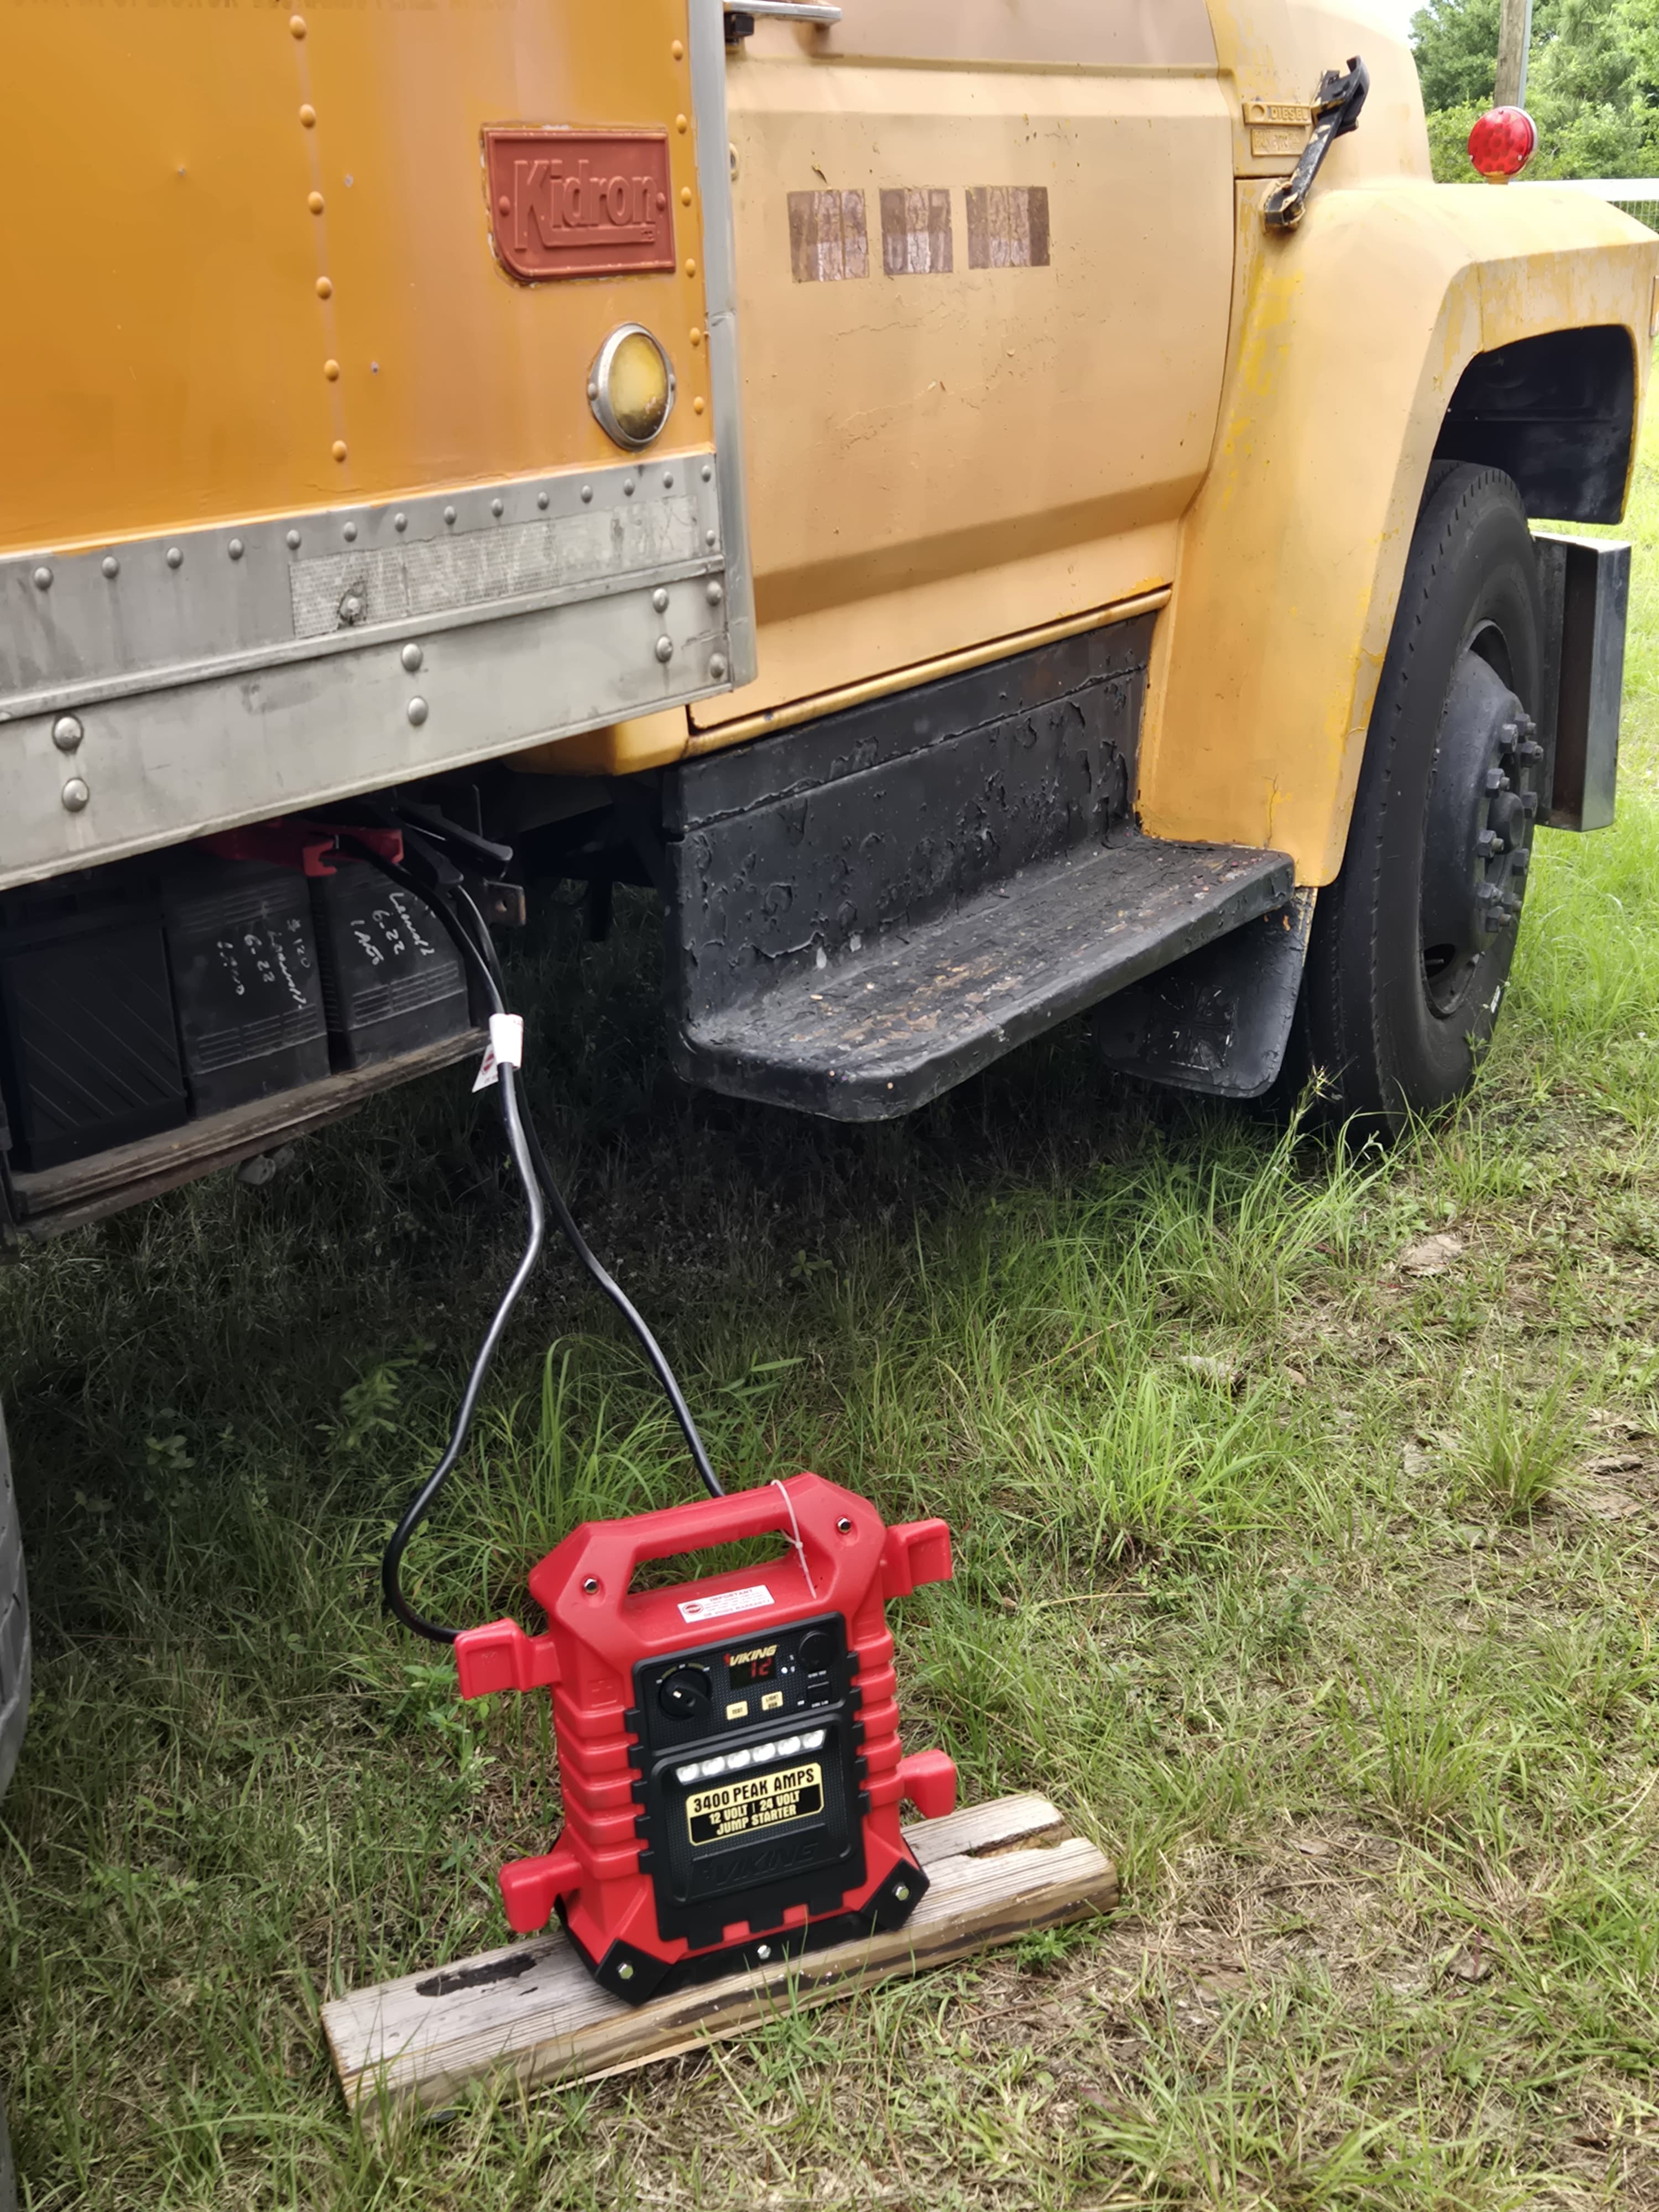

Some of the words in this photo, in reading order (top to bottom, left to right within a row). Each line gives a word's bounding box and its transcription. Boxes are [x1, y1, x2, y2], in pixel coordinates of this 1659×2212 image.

[1270, 107, 1308, 121] DIESEL
[514, 158, 657, 252] Kidron
[709, 1589, 753, 1601] IMPORTANT
[729, 1645, 778, 1667] VIKING
[750, 1657, 773, 1678] 12
[694, 1791, 730, 1813] 3400
[733, 1780, 768, 1802] PEAK
[774, 1768, 814, 1791] AMPS
[709, 1812, 721, 1825] 12
[723, 1804, 748, 1821] VOLT
[759, 1799, 773, 1812] 24
[776, 1790, 800, 1806] VOLT
[716, 1817, 749, 1835] JUMP
[751, 1804, 796, 1826] STARTER
[715, 1842, 819, 1886] VIKING
